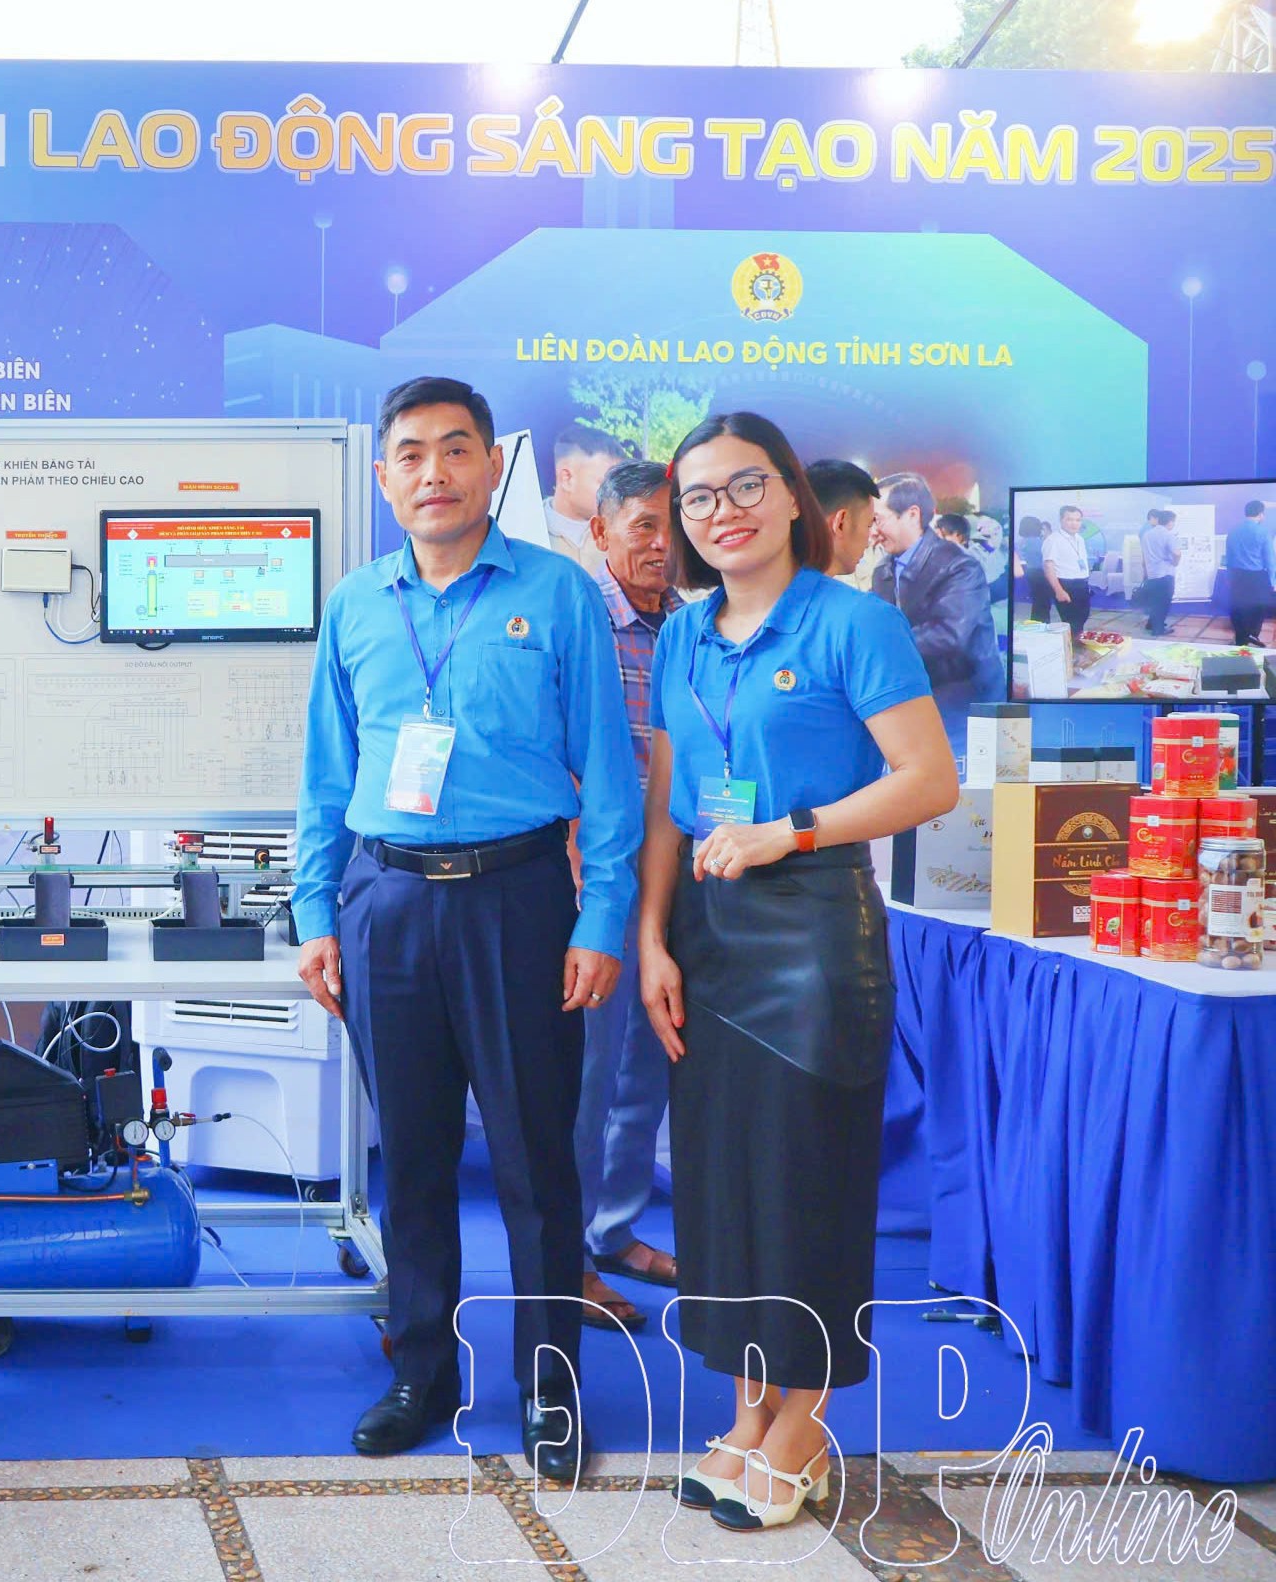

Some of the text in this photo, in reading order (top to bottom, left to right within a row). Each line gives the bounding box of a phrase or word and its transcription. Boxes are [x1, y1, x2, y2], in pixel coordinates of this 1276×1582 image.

[29, 109, 199, 170] LAO
[212, 93, 454, 185] ĐỘNG
[467, 95, 694, 178] SÁNG
[705, 116, 877, 191] TẠO
[891, 109, 1078, 184] NĂM
[1090, 125, 1276, 185] 2025
[516, 332, 1013, 370] LIÊN ĐOÀN LAO ĐỘNG TỈNH SƠN LA
[24, 389, 70, 411] BIÊN
[47, 475, 78, 486] THEO
[119, 475, 144, 486] CAO
[1079, 854, 1101, 868] Linh
